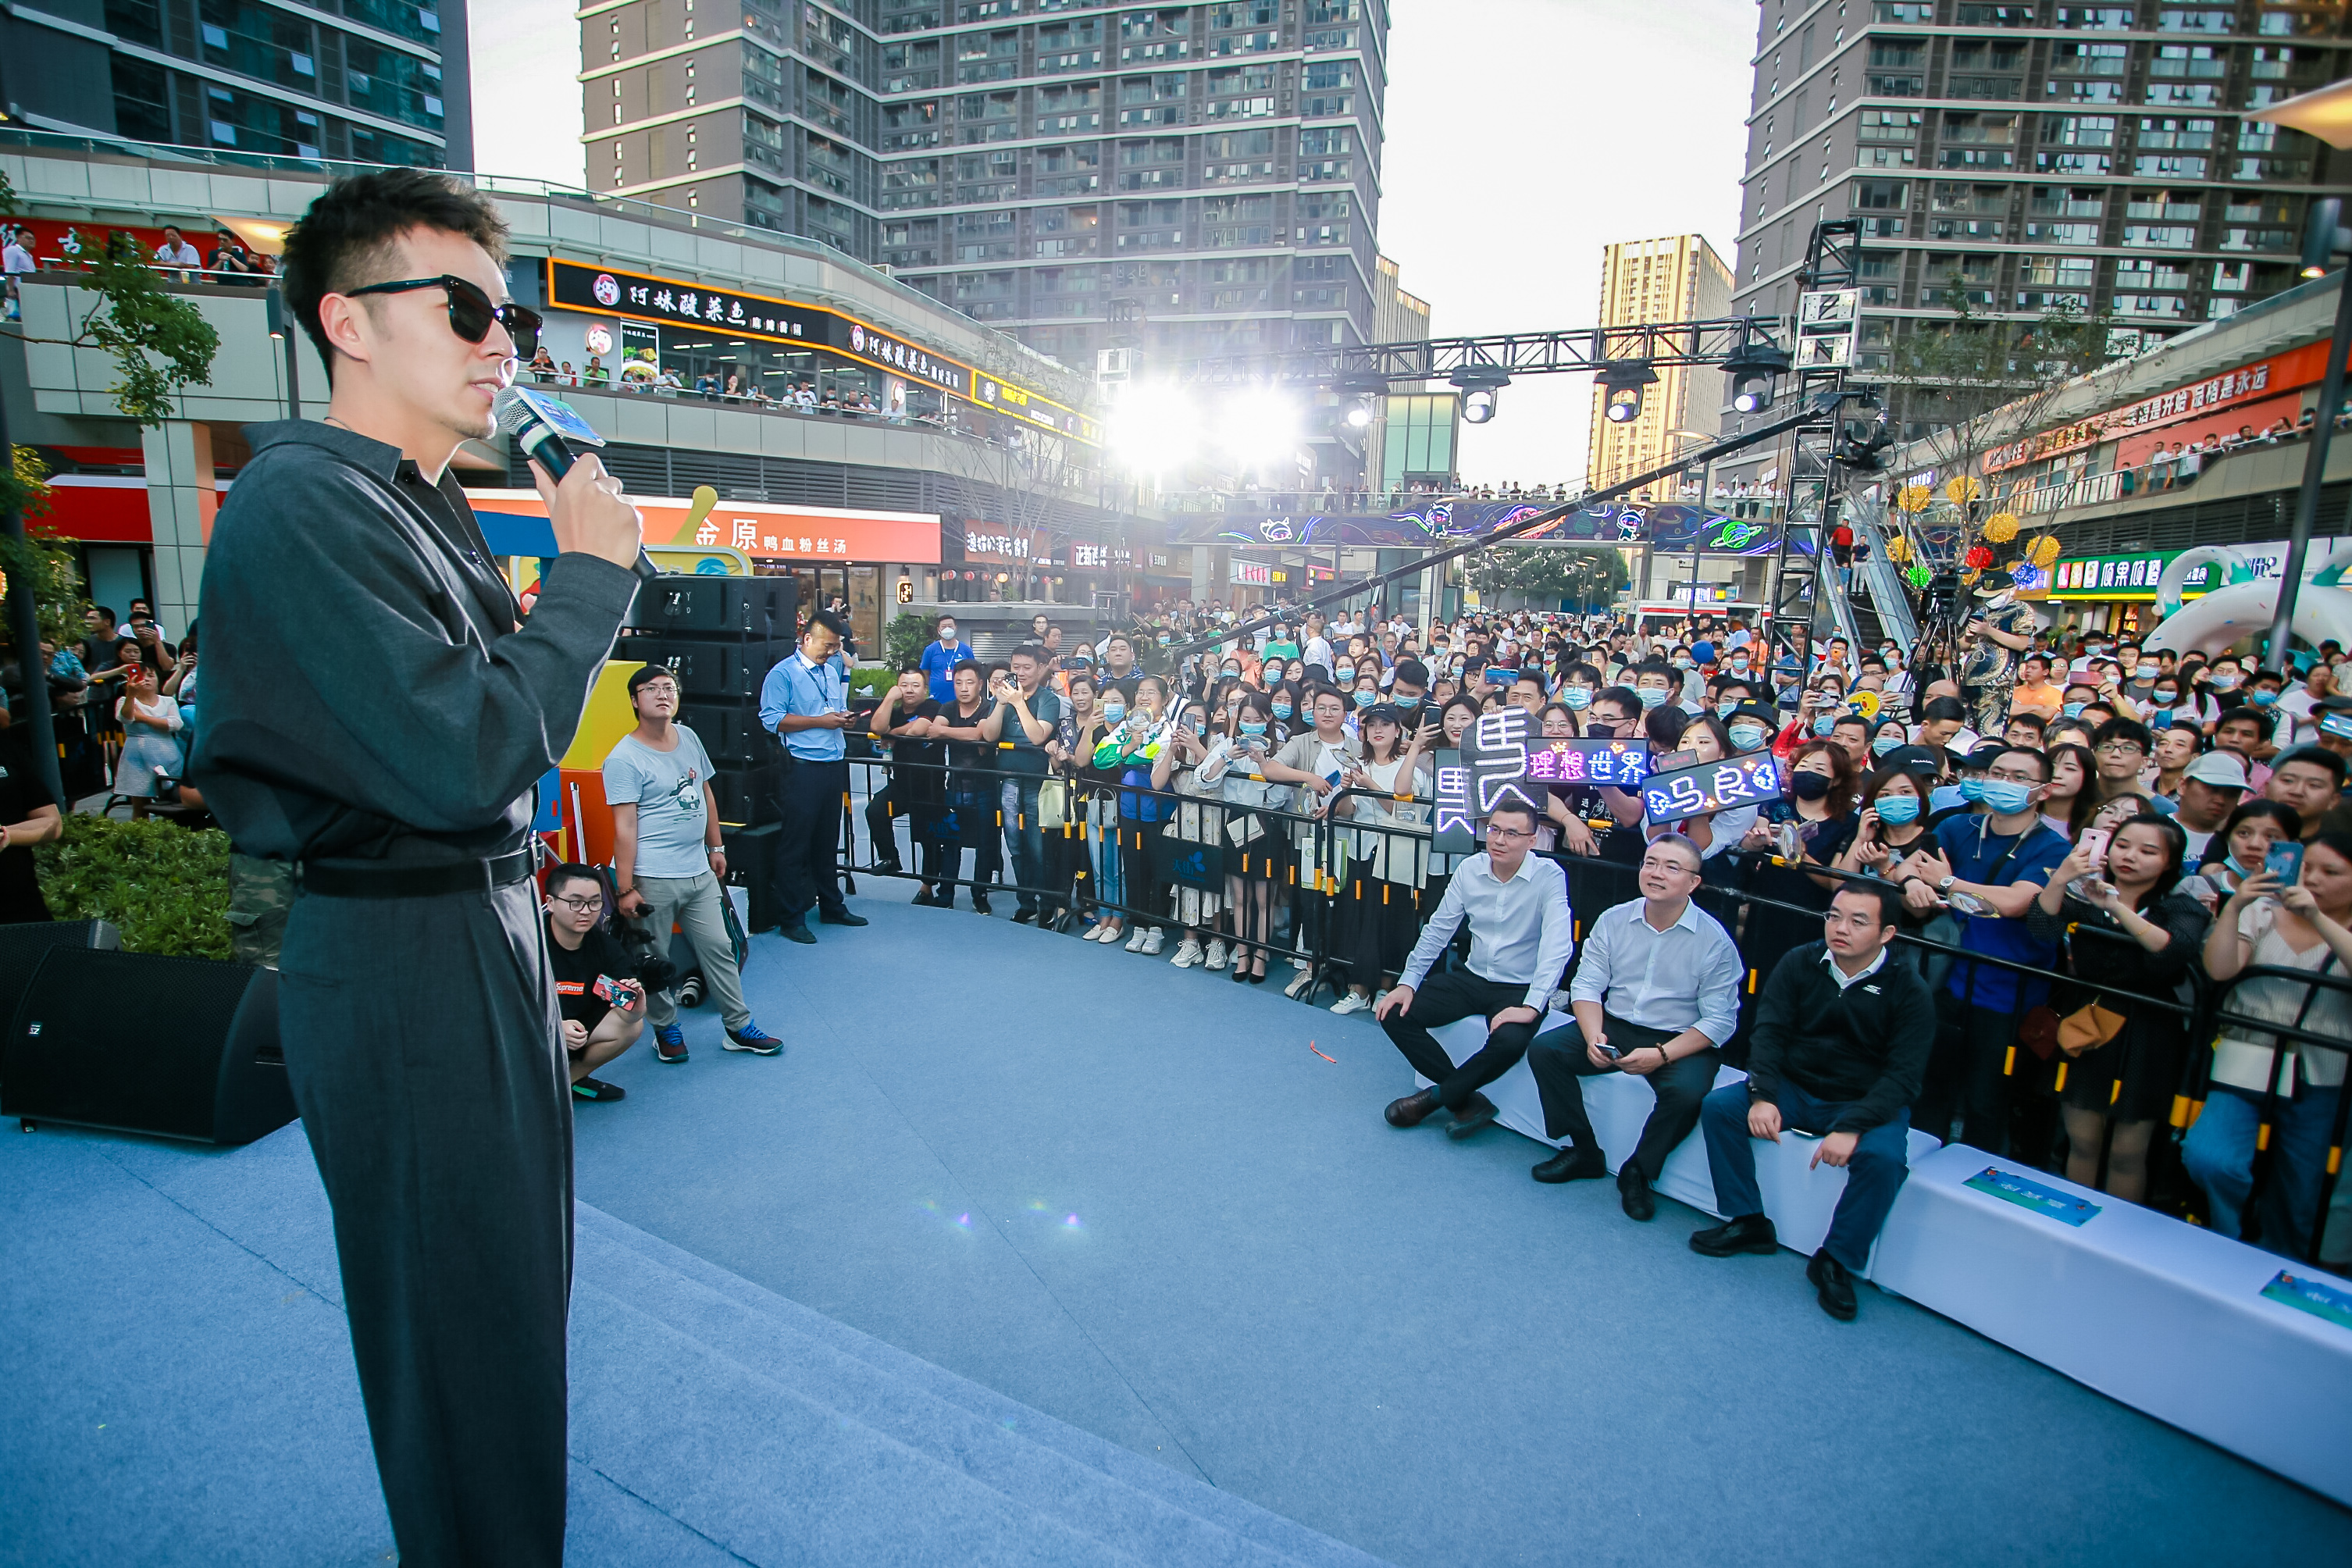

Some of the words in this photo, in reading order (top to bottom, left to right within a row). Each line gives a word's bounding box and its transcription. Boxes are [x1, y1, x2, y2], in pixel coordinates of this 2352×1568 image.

[629, 286, 747, 326] 阿妹酸菜鱼
[868, 336, 929, 376] 阿妹酸菜鱼
[695, 517, 758, 550] 金原
[764, 536, 846, 554] 鸭血粉丝汤
[1529, 750, 1647, 784] 理想世界
[1669, 765, 1755, 813] 马良
[555, 982, 584, 992] Supreme
